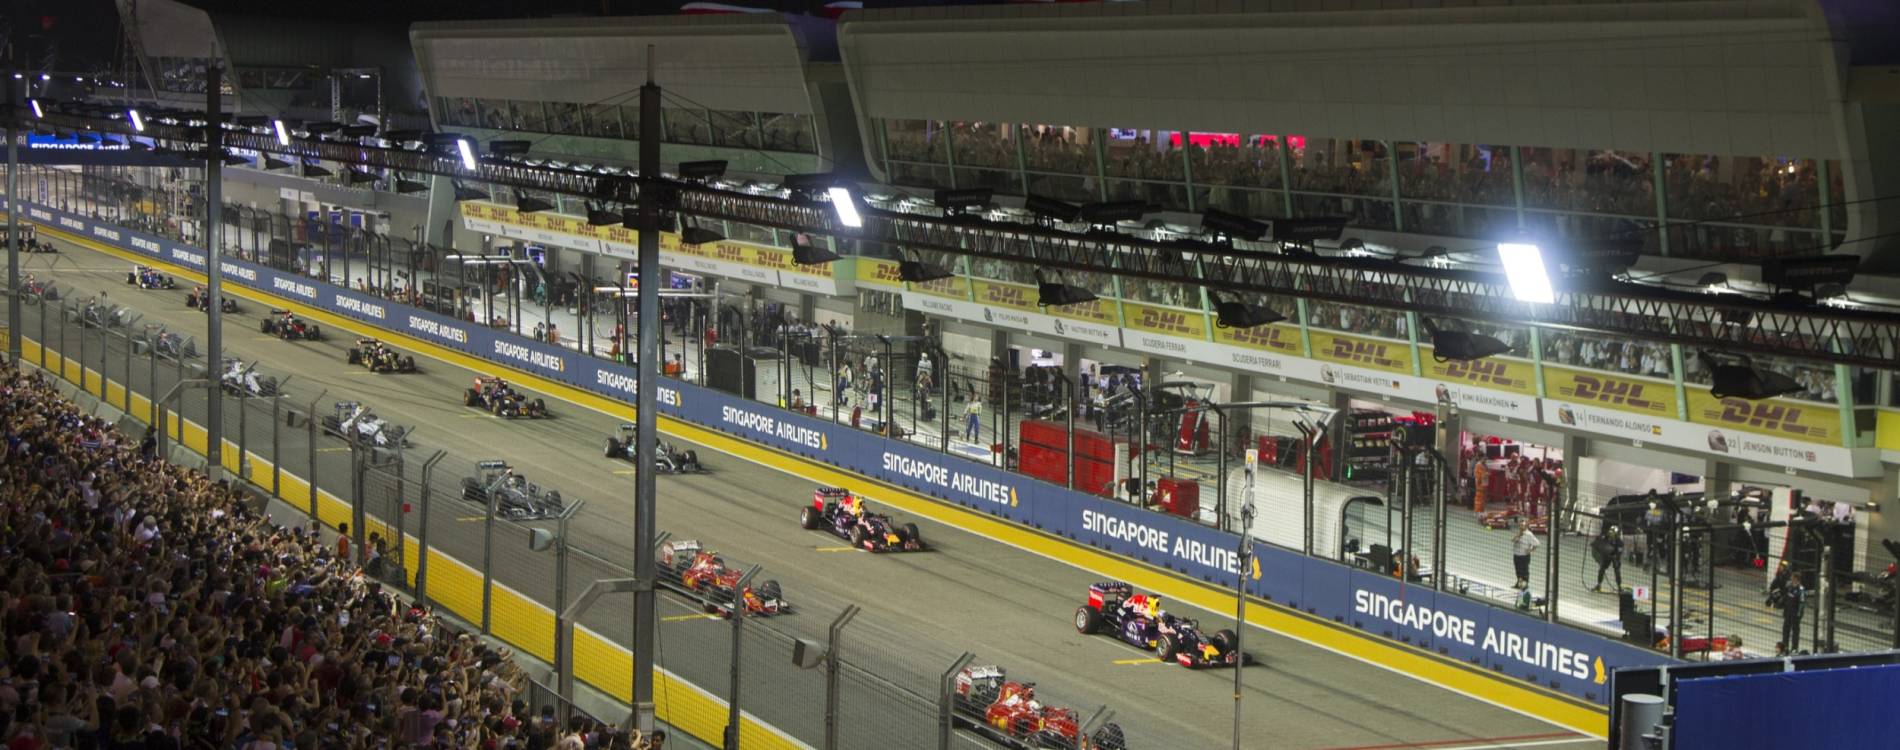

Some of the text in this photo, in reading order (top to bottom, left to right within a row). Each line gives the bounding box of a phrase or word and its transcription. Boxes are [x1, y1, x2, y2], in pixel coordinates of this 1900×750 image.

[609, 227, 632, 243] DHL
[717, 244, 744, 262] DHL
[757, 250, 786, 269] DHL
[336, 294, 382, 318] SINGAPORE AIRLINES
[988, 284, 1027, 306] DHL
[409, 316, 463, 343] SINGAPORE AIRLINES
[1142, 308, 1190, 334] DHL
[495, 340, 560, 371] SINGAPORE AIRLINES
[1232, 353, 1282, 369] SCUDERIA FERRARI
[1333, 338, 1392, 366] DHL
[1446, 359, 1512, 385] DHL
[1573, 374, 1649, 408] DHL
[722, 405, 820, 449] SINGAPORE AIRLINES
[1588, 414, 1624, 427] FERNANDO
[1625, 420, 1651, 433] ALONSO
[1721, 396, 1808, 434] DHL
[1728, 438, 1803, 459] 22 JENSON BUTTON
[883, 452, 1009, 505] SINGAPORE AIRLINES
[1082, 509, 1168, 553] SINGAPORE
[1355, 589, 1590, 680] SINGAPORE AIRLINES
